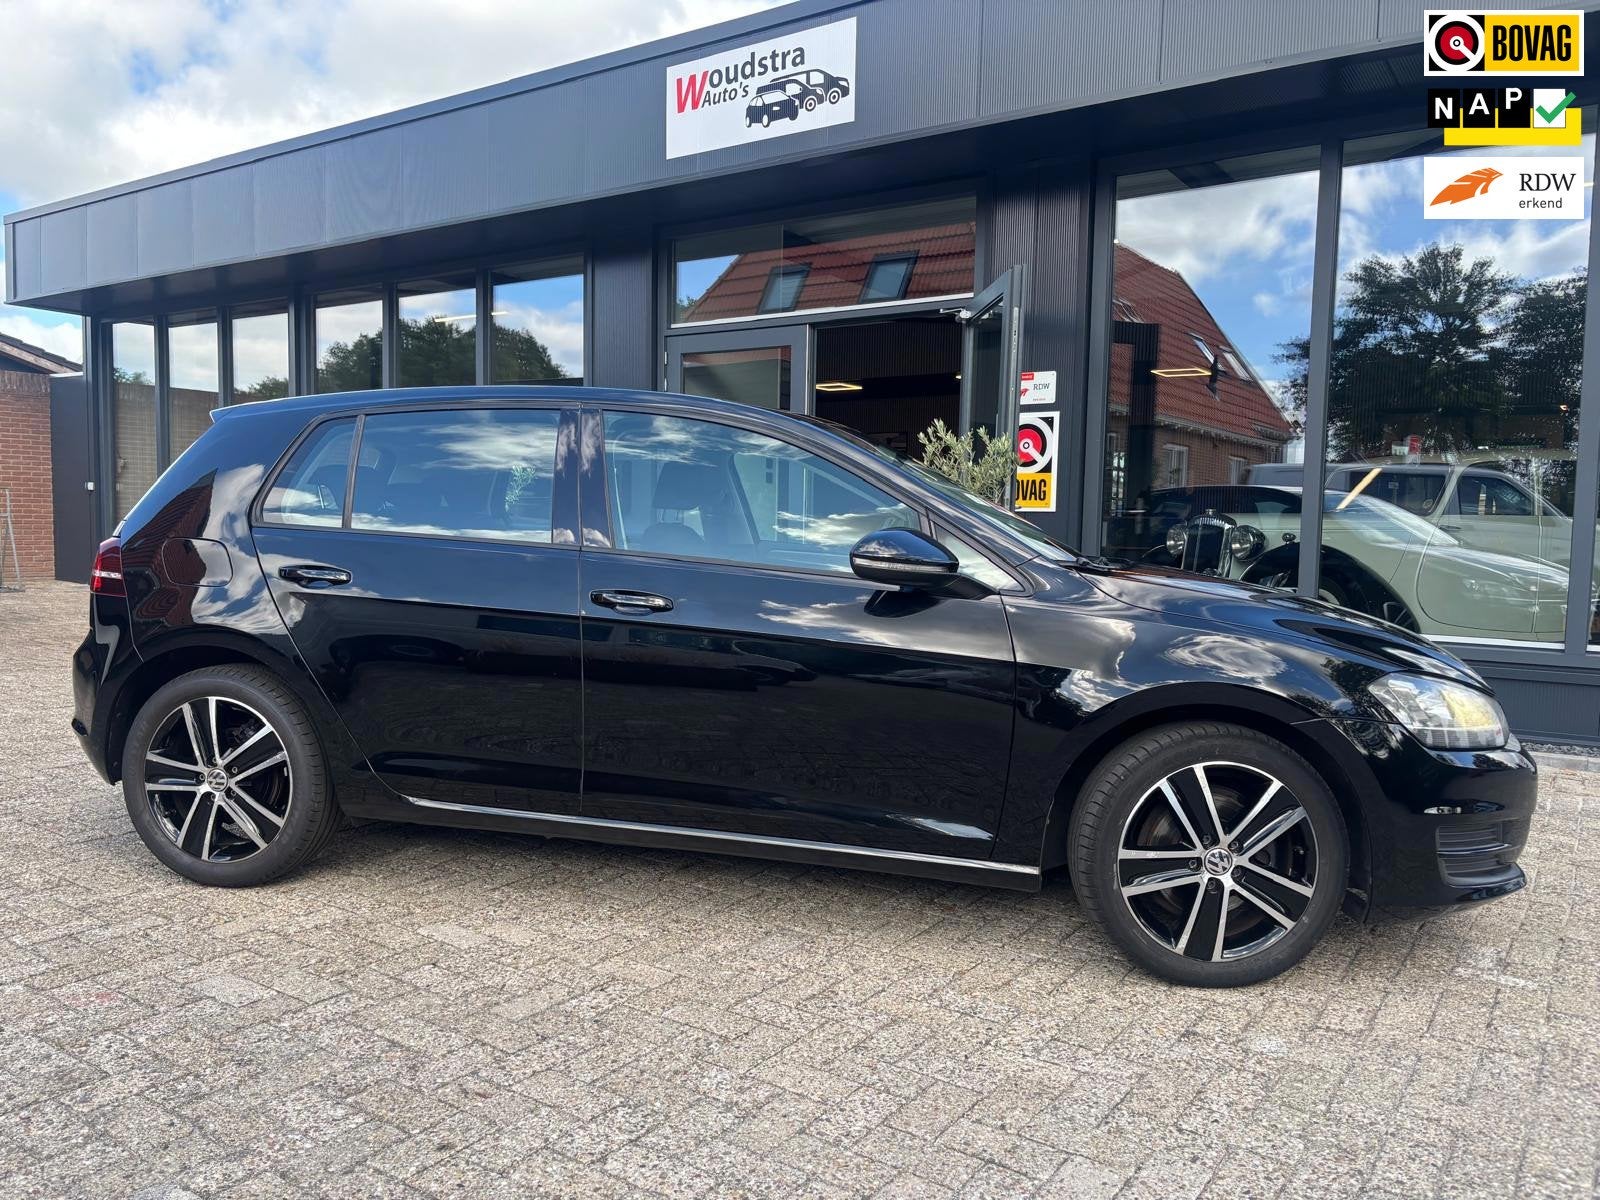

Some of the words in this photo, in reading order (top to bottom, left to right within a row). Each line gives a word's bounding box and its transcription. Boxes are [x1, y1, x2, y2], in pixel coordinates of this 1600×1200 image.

[676, 47, 805, 114] Woudstra
[701, 82, 749, 108] Auto's
[1033, 382, 1050, 391] RDW
